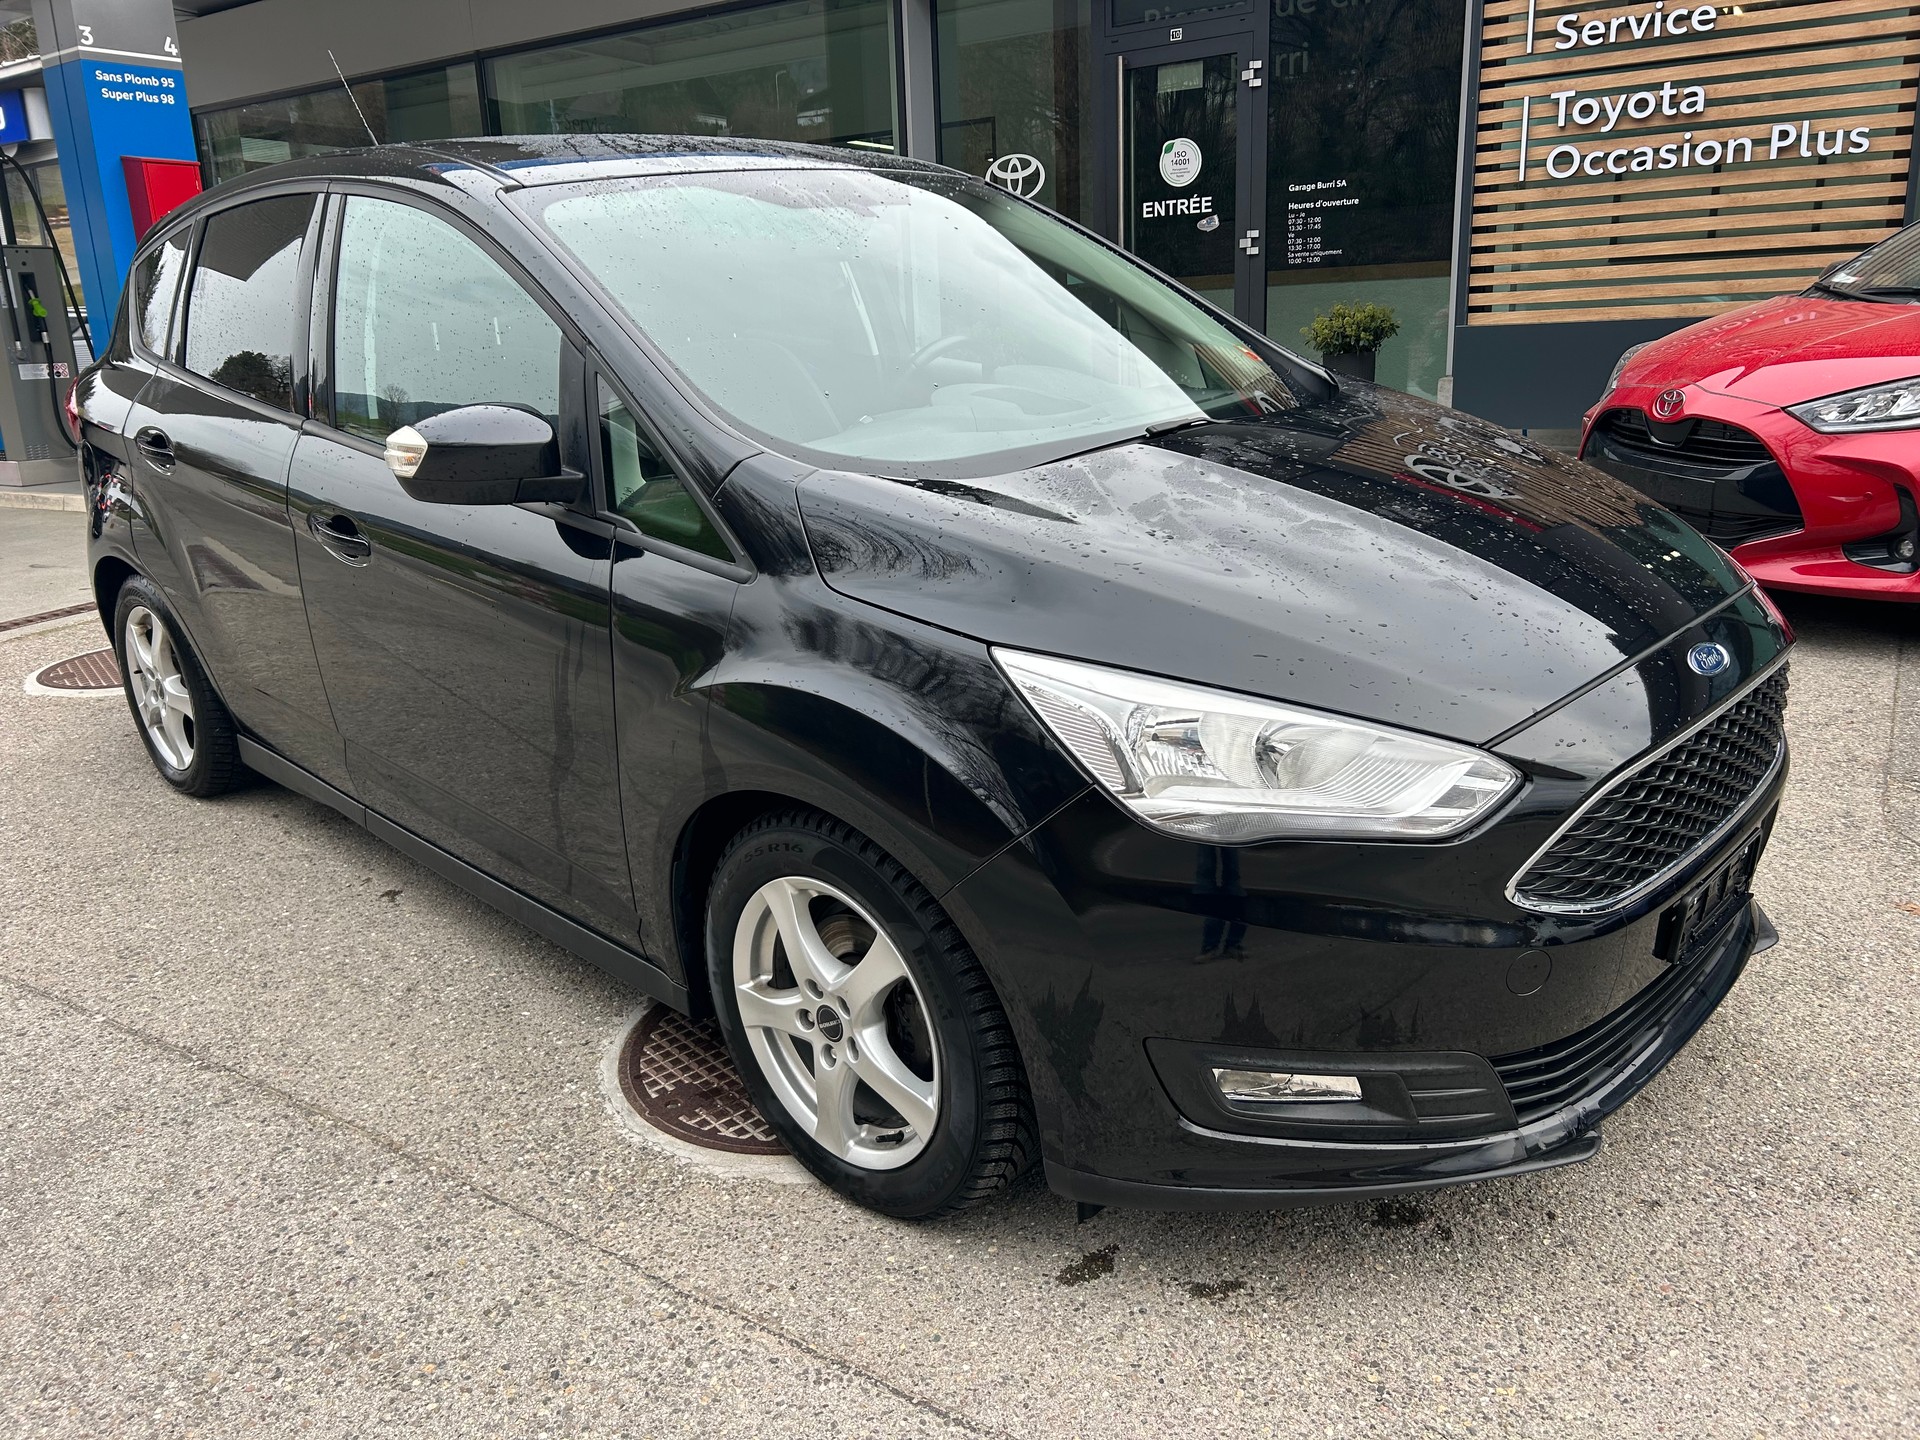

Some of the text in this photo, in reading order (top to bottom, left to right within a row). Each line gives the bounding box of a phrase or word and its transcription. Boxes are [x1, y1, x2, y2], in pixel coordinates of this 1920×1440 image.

[1554, 1, 1718, 51] Service
[78, 25, 179, 56] 3 4
[95, 70, 175, 88] Sans Plomb 95
[101, 88, 175, 105] Super Plus 98
[1550, 81, 1707, 133] Toyota
[1546, 120, 1871, 179] Occasion Plus
[1170, 158, 1190, 166] 14001
[1288, 179, 1347, 192] Garage Burri SA
[1142, 193, 1213, 218] ENTRÉE
[1288, 198, 1359, 210] Heures d'ouverture
[767, 843, 804, 853] R16
